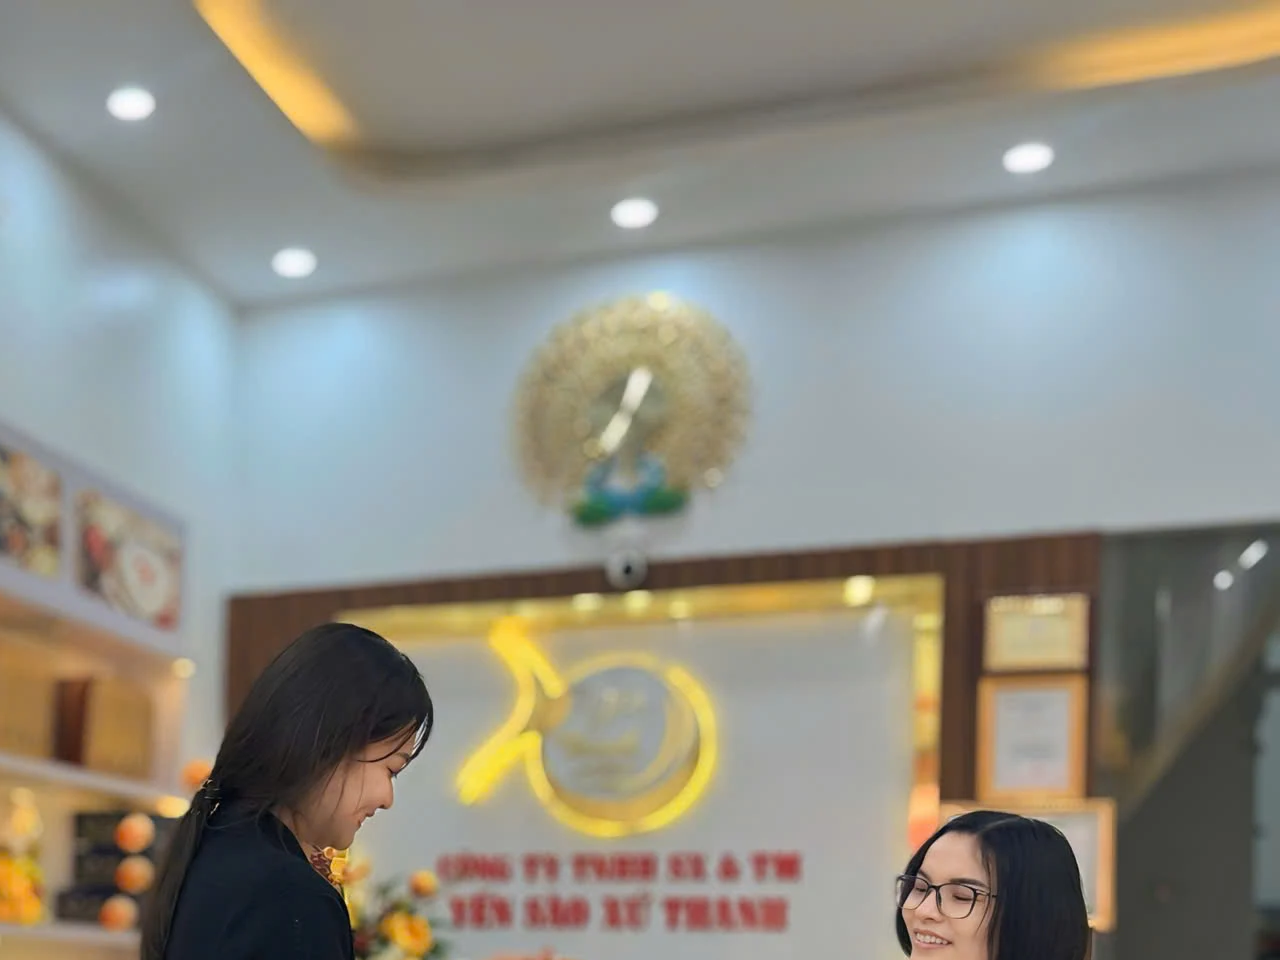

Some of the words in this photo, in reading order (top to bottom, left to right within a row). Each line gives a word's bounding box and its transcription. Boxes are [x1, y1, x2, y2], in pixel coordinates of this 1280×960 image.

[436, 849, 511, 881] CÔNG
[522, 852, 560, 881] TY
[571, 853, 658, 882] TNHH
[717, 852, 741, 882] &
[749, 852, 803, 881] TM
[664, 898, 789, 932] THANH
